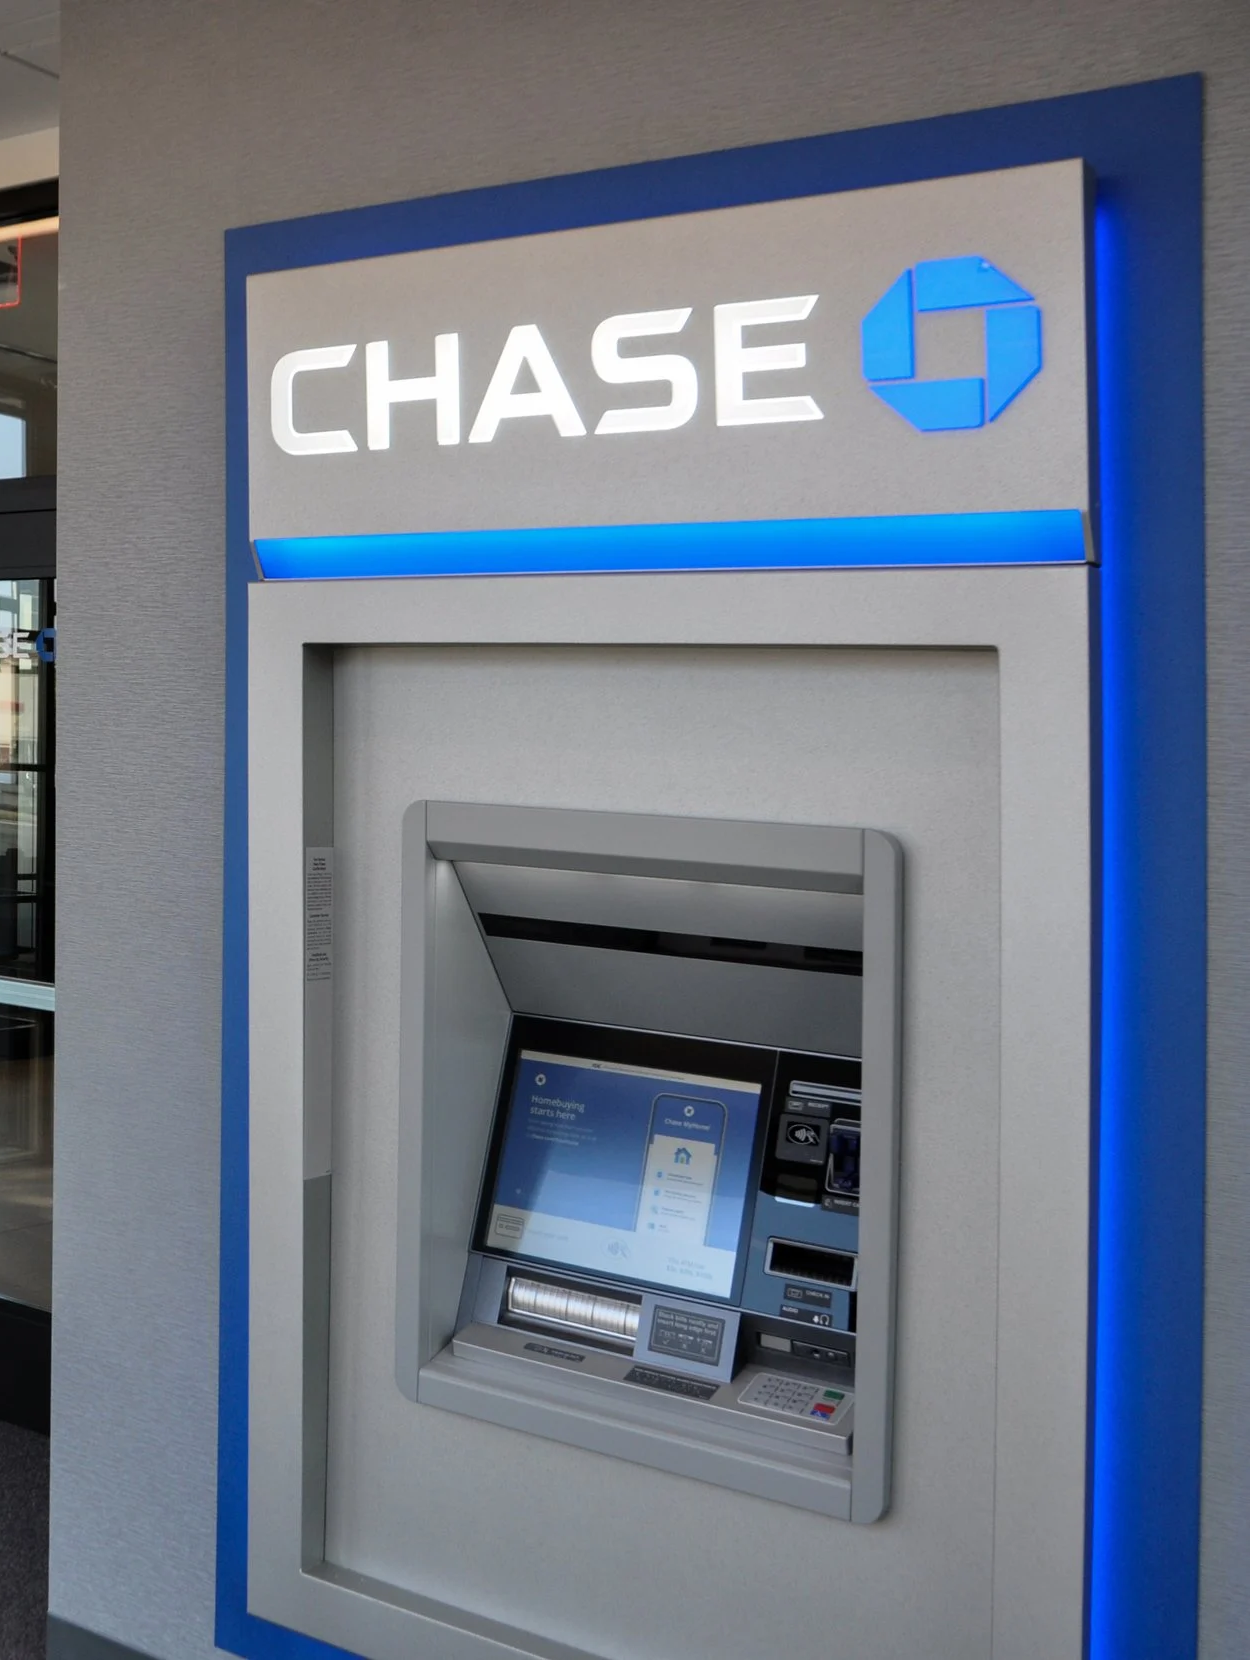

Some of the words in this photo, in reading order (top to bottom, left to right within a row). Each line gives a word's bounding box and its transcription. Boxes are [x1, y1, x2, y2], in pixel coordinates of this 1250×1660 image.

[270, 294, 825, 456] CHASE
[530, 1106, 554, 1117] starts
[555, 1109, 576, 1120] here
[531, 1094, 585, 1113] Homebuying
